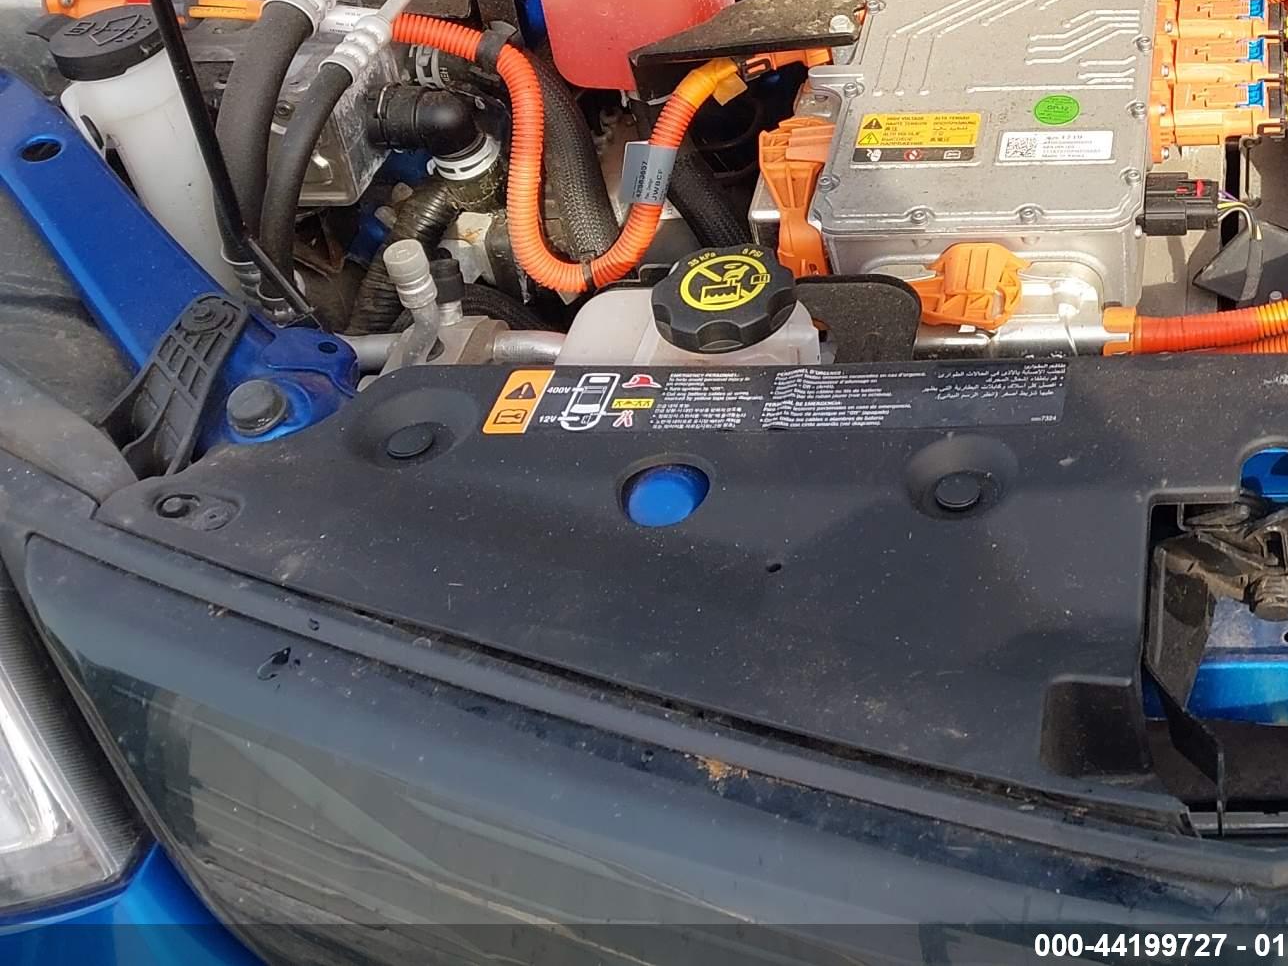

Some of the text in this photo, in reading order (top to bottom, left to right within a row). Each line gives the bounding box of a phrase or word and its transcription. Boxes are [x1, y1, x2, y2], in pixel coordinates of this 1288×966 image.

[699, 252, 716, 261] kPa
[749, 249, 764, 258] PSI
[546, 386, 571, 394] 400V
[539, 415, 557, 423] 12V
